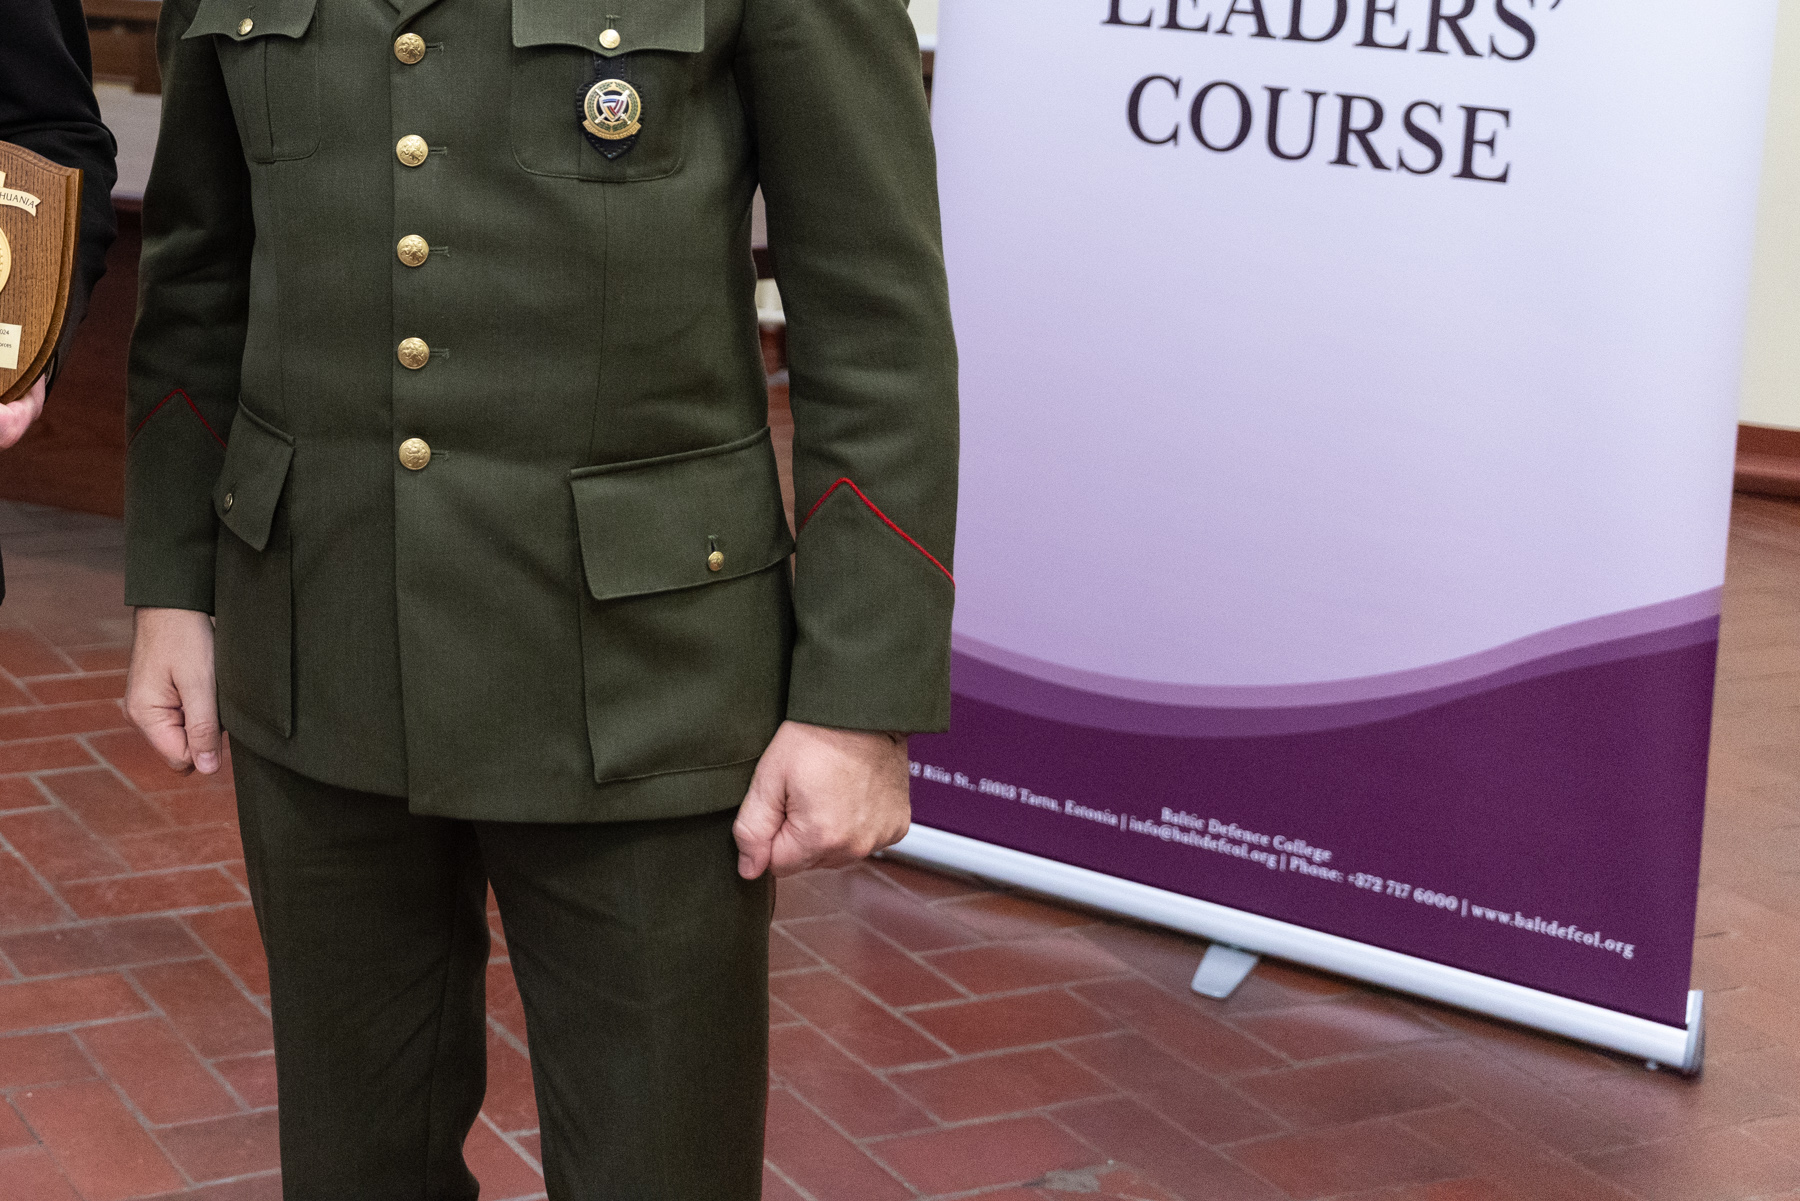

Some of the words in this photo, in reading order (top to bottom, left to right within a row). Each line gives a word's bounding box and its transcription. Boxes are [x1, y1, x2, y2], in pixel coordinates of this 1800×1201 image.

[1125, 72, 1512, 184] COURSE
[922, 764, 952, 785] Riia
[1064, 799, 1119, 827] Estonia
[1129, 815, 1278, 870] info@baltdefcol.org
[1289, 855, 1344, 884] Phone:
[1386, 879, 1412, 898] 717
[1413, 887, 1459, 912] 6000
[1470, 904, 1636, 960] www.baltdefcol.org
[1161, 806, 1206, 831] Baltic
[1208, 818, 1271, 848] Defence
[1272, 835, 1333, 864] College
